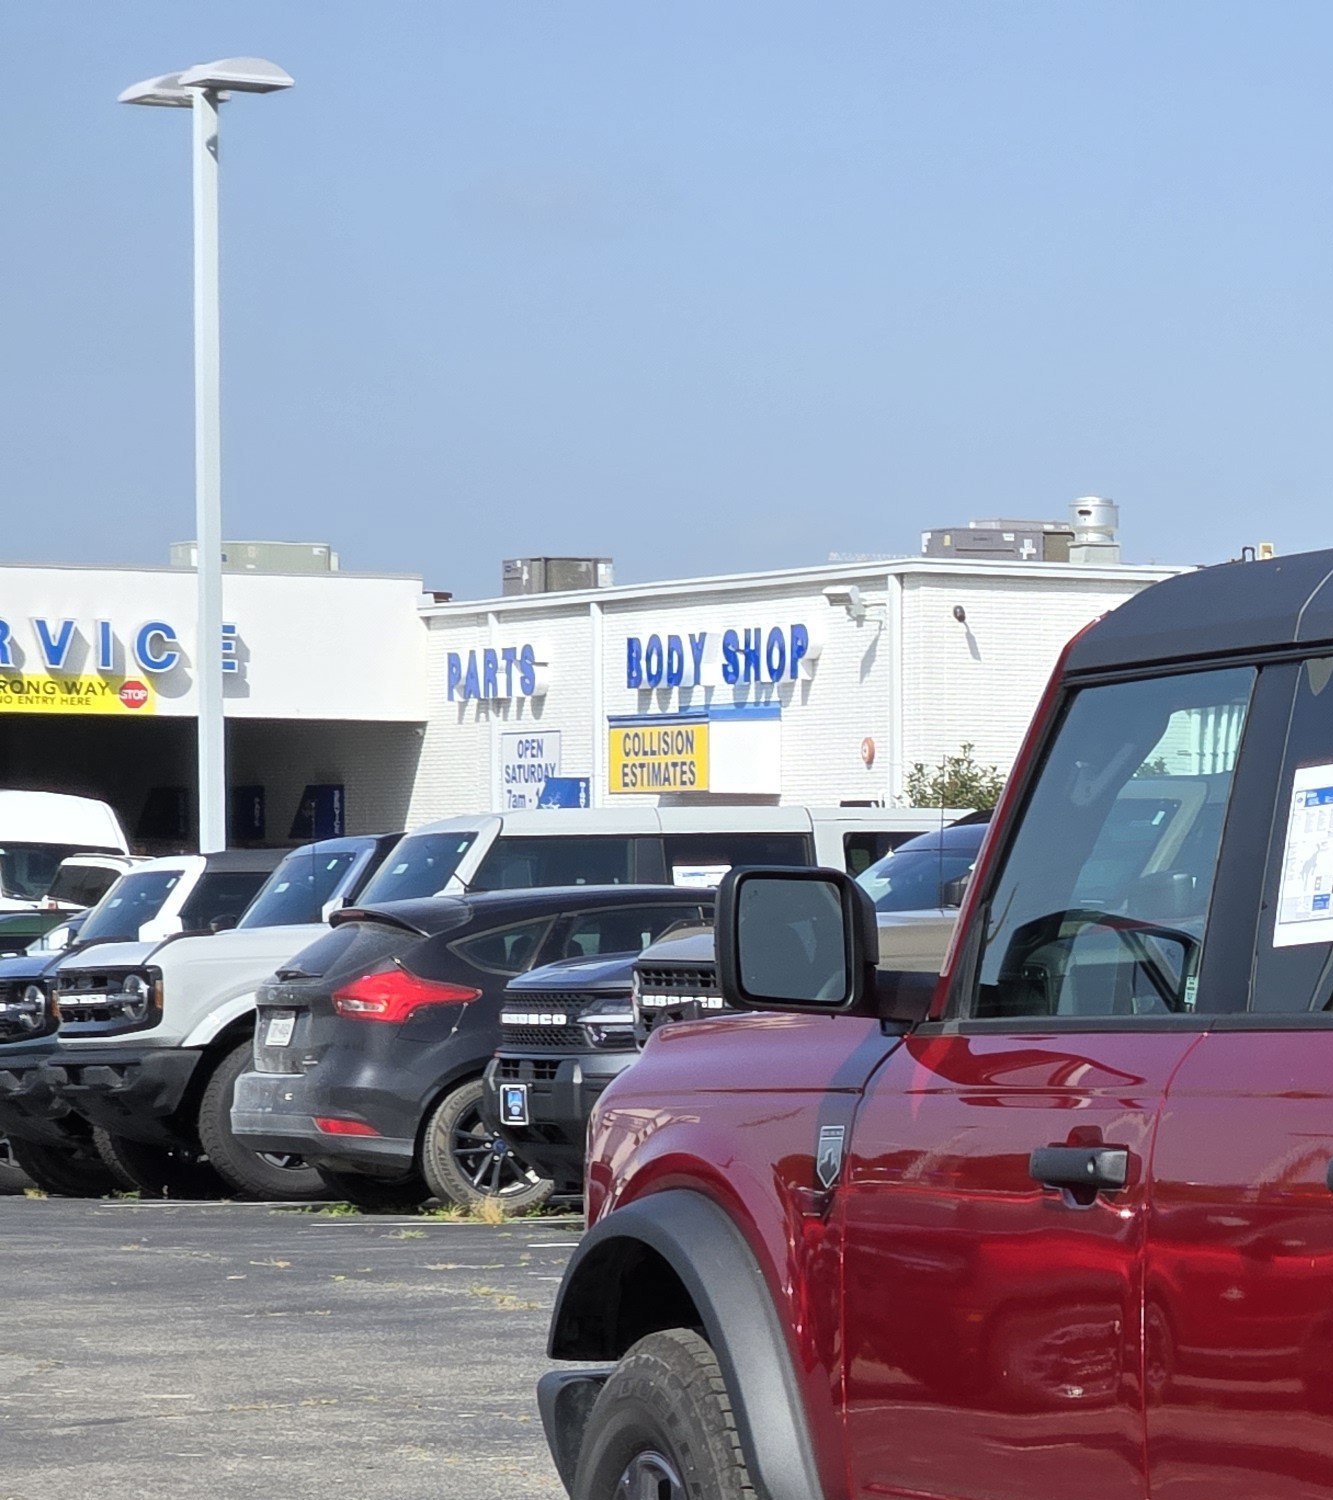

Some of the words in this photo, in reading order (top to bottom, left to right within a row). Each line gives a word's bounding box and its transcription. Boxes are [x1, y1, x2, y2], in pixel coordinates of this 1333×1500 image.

[626, 632, 707, 690] BODY
[722, 623, 810, 685] SHOP
[447, 643, 536, 702] PARTS
[64, 681, 110, 696] WAY
[120, 690, 148, 700] STOP
[18, 696, 56, 705] ENTRY
[60, 697, 91, 706] HERE
[517, 739, 544, 759] OPEN
[622, 729, 695, 758] COLLISION
[505, 763, 556, 784] SATURDAY
[621, 761, 697, 788] ESTIMATES
[507, 789, 526, 808] 7am
